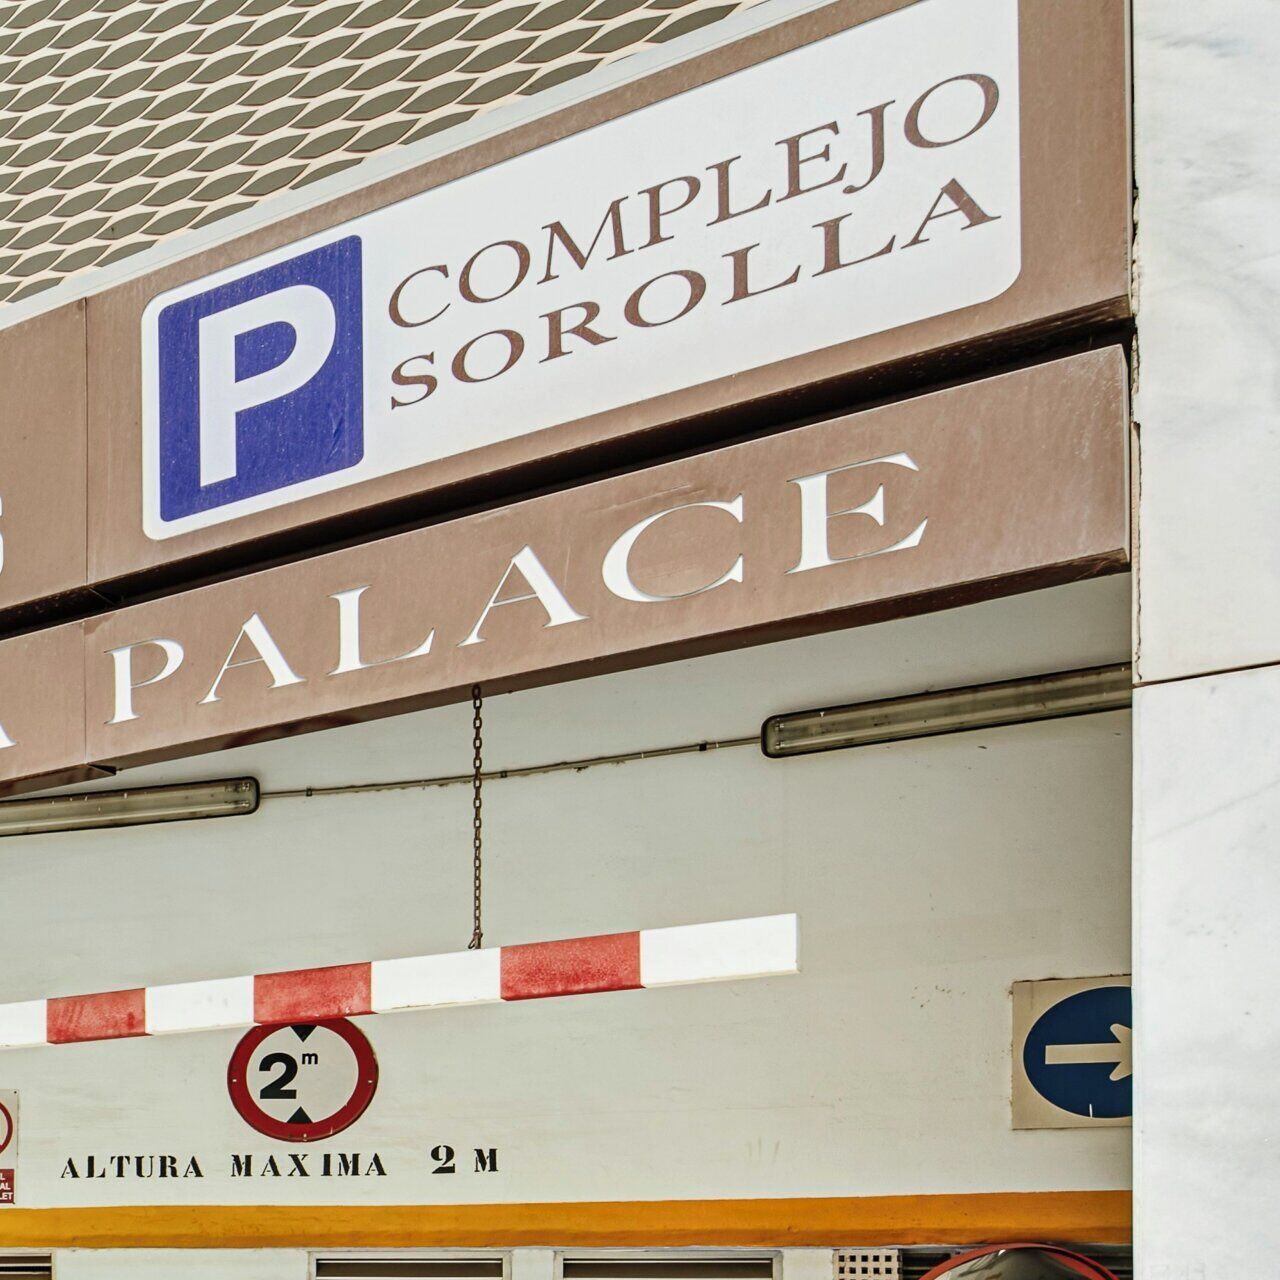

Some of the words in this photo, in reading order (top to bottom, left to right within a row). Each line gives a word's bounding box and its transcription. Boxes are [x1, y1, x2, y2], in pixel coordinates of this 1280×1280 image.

[388, 73, 1000, 328] COMPLEJO
[390, 177, 1002, 411] SOROLLA
[198, 283, 338, 488] P
[105, 451, 928, 724] PALACE
[60, 1154, 204, 1179] ALTURA
[230, 1152, 388, 1177] MAXIMA
